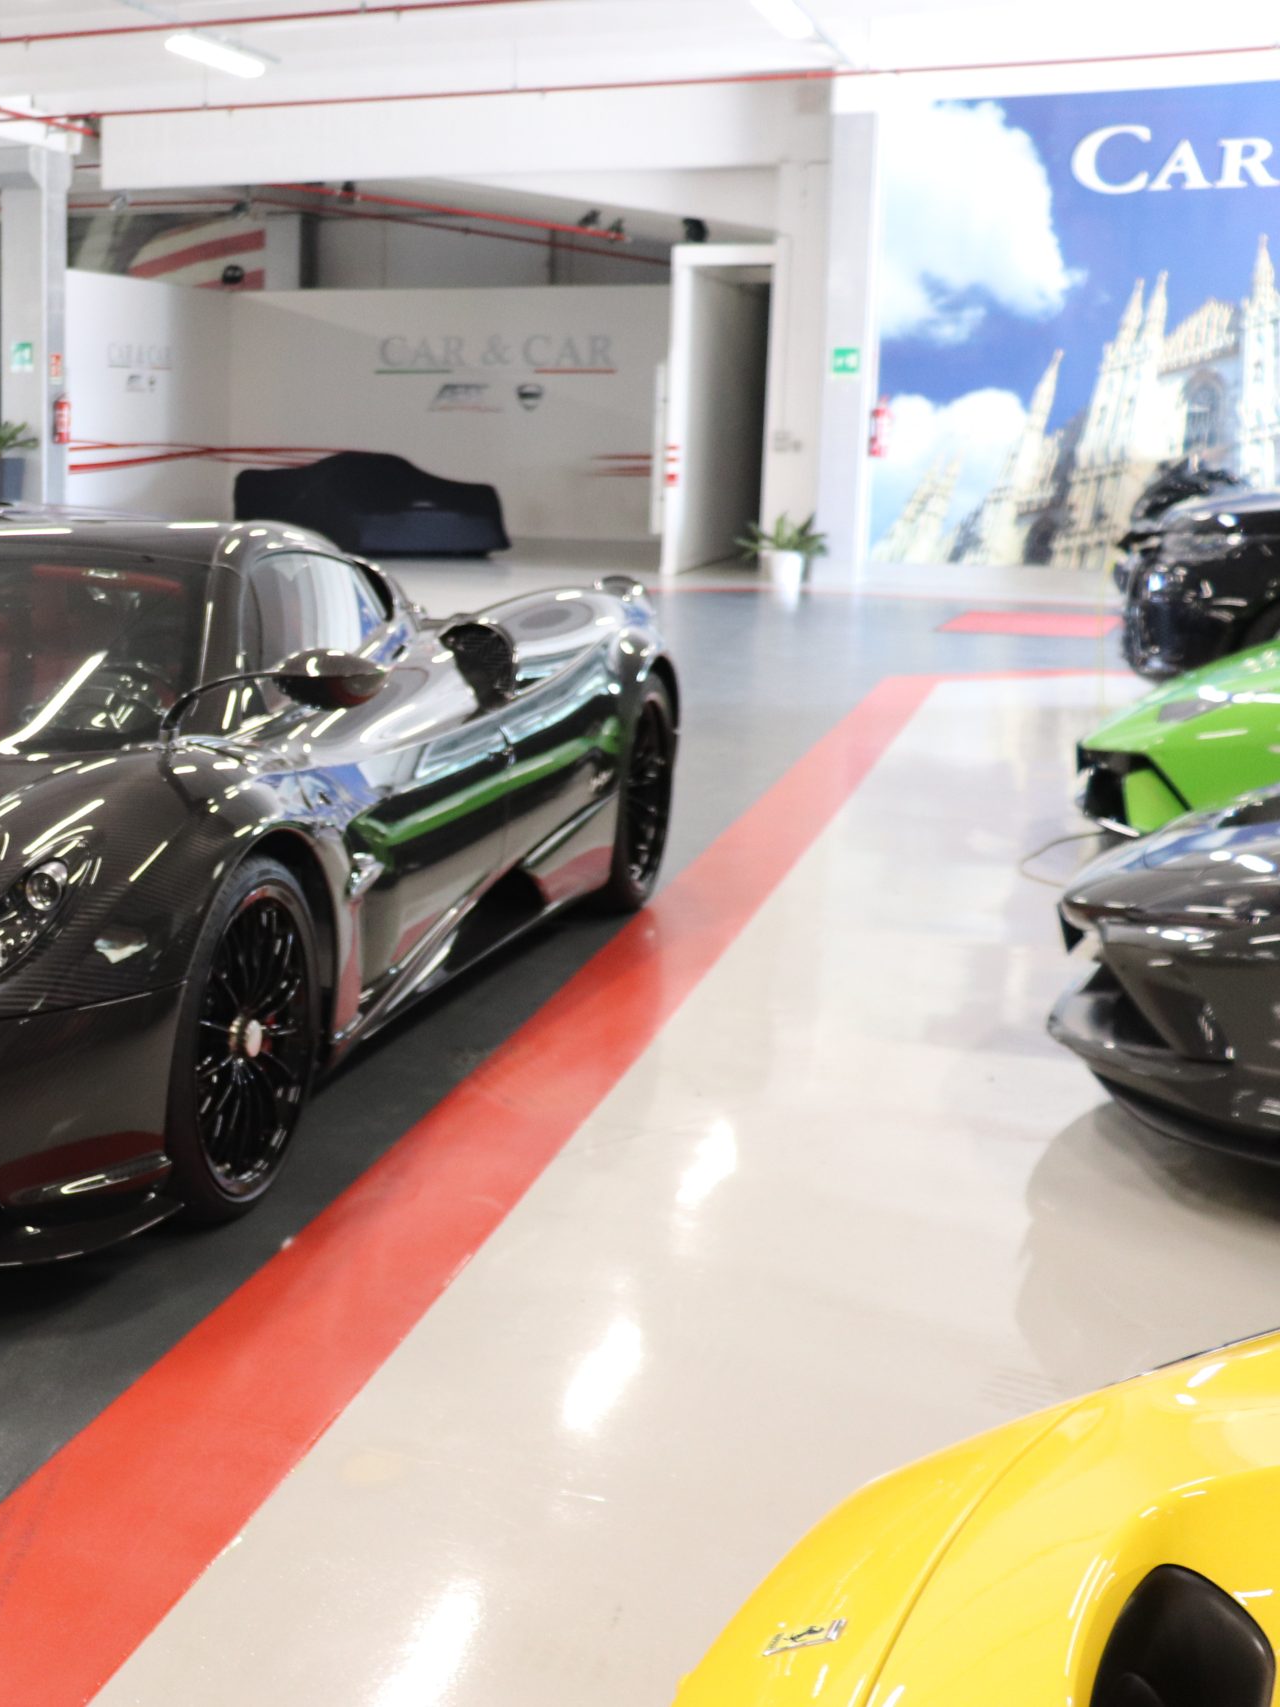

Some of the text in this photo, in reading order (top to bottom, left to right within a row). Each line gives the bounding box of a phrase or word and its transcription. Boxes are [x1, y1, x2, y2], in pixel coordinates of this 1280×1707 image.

[1071, 124, 1280, 195] CAR
[379, 334, 615, 367] CAR & CAR
